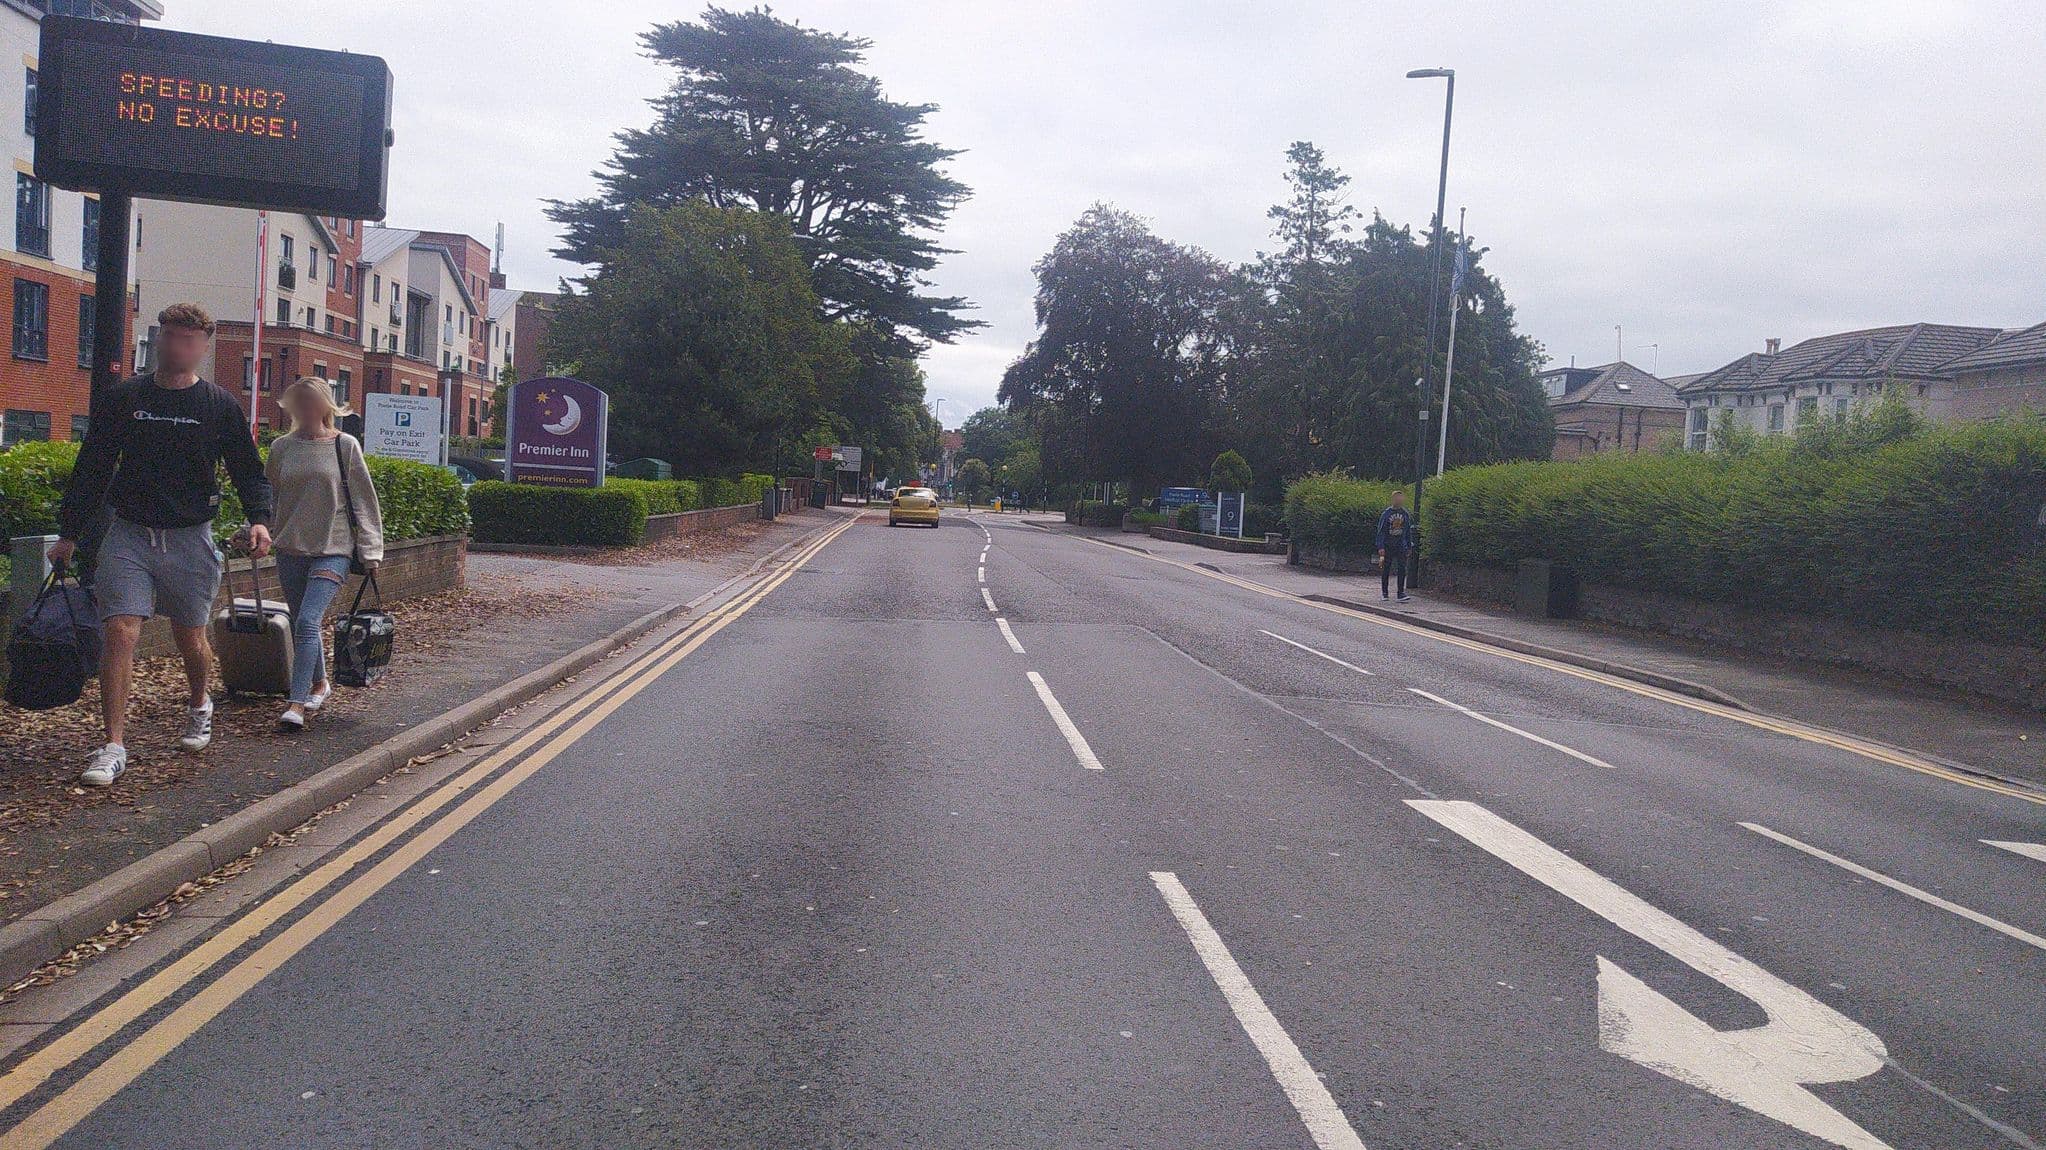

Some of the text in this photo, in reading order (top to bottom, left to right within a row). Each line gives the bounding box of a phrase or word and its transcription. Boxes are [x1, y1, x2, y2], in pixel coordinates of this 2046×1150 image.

[120, 71, 287, 111] SPEEDING?
[118, 100, 299, 139] NO EXCUSE!
[133, 410, 201, 426] Champion
[398, 413, 409, 426] P
[380, 428, 395, 437] Pay
[409, 430, 425, 438] Exit
[384, 438, 421, 447] Car Park
[519, 442, 589, 458] Premier Inn
[518, 474, 588, 484] premierinn.com
[1227, 511, 1235, 522] 9
